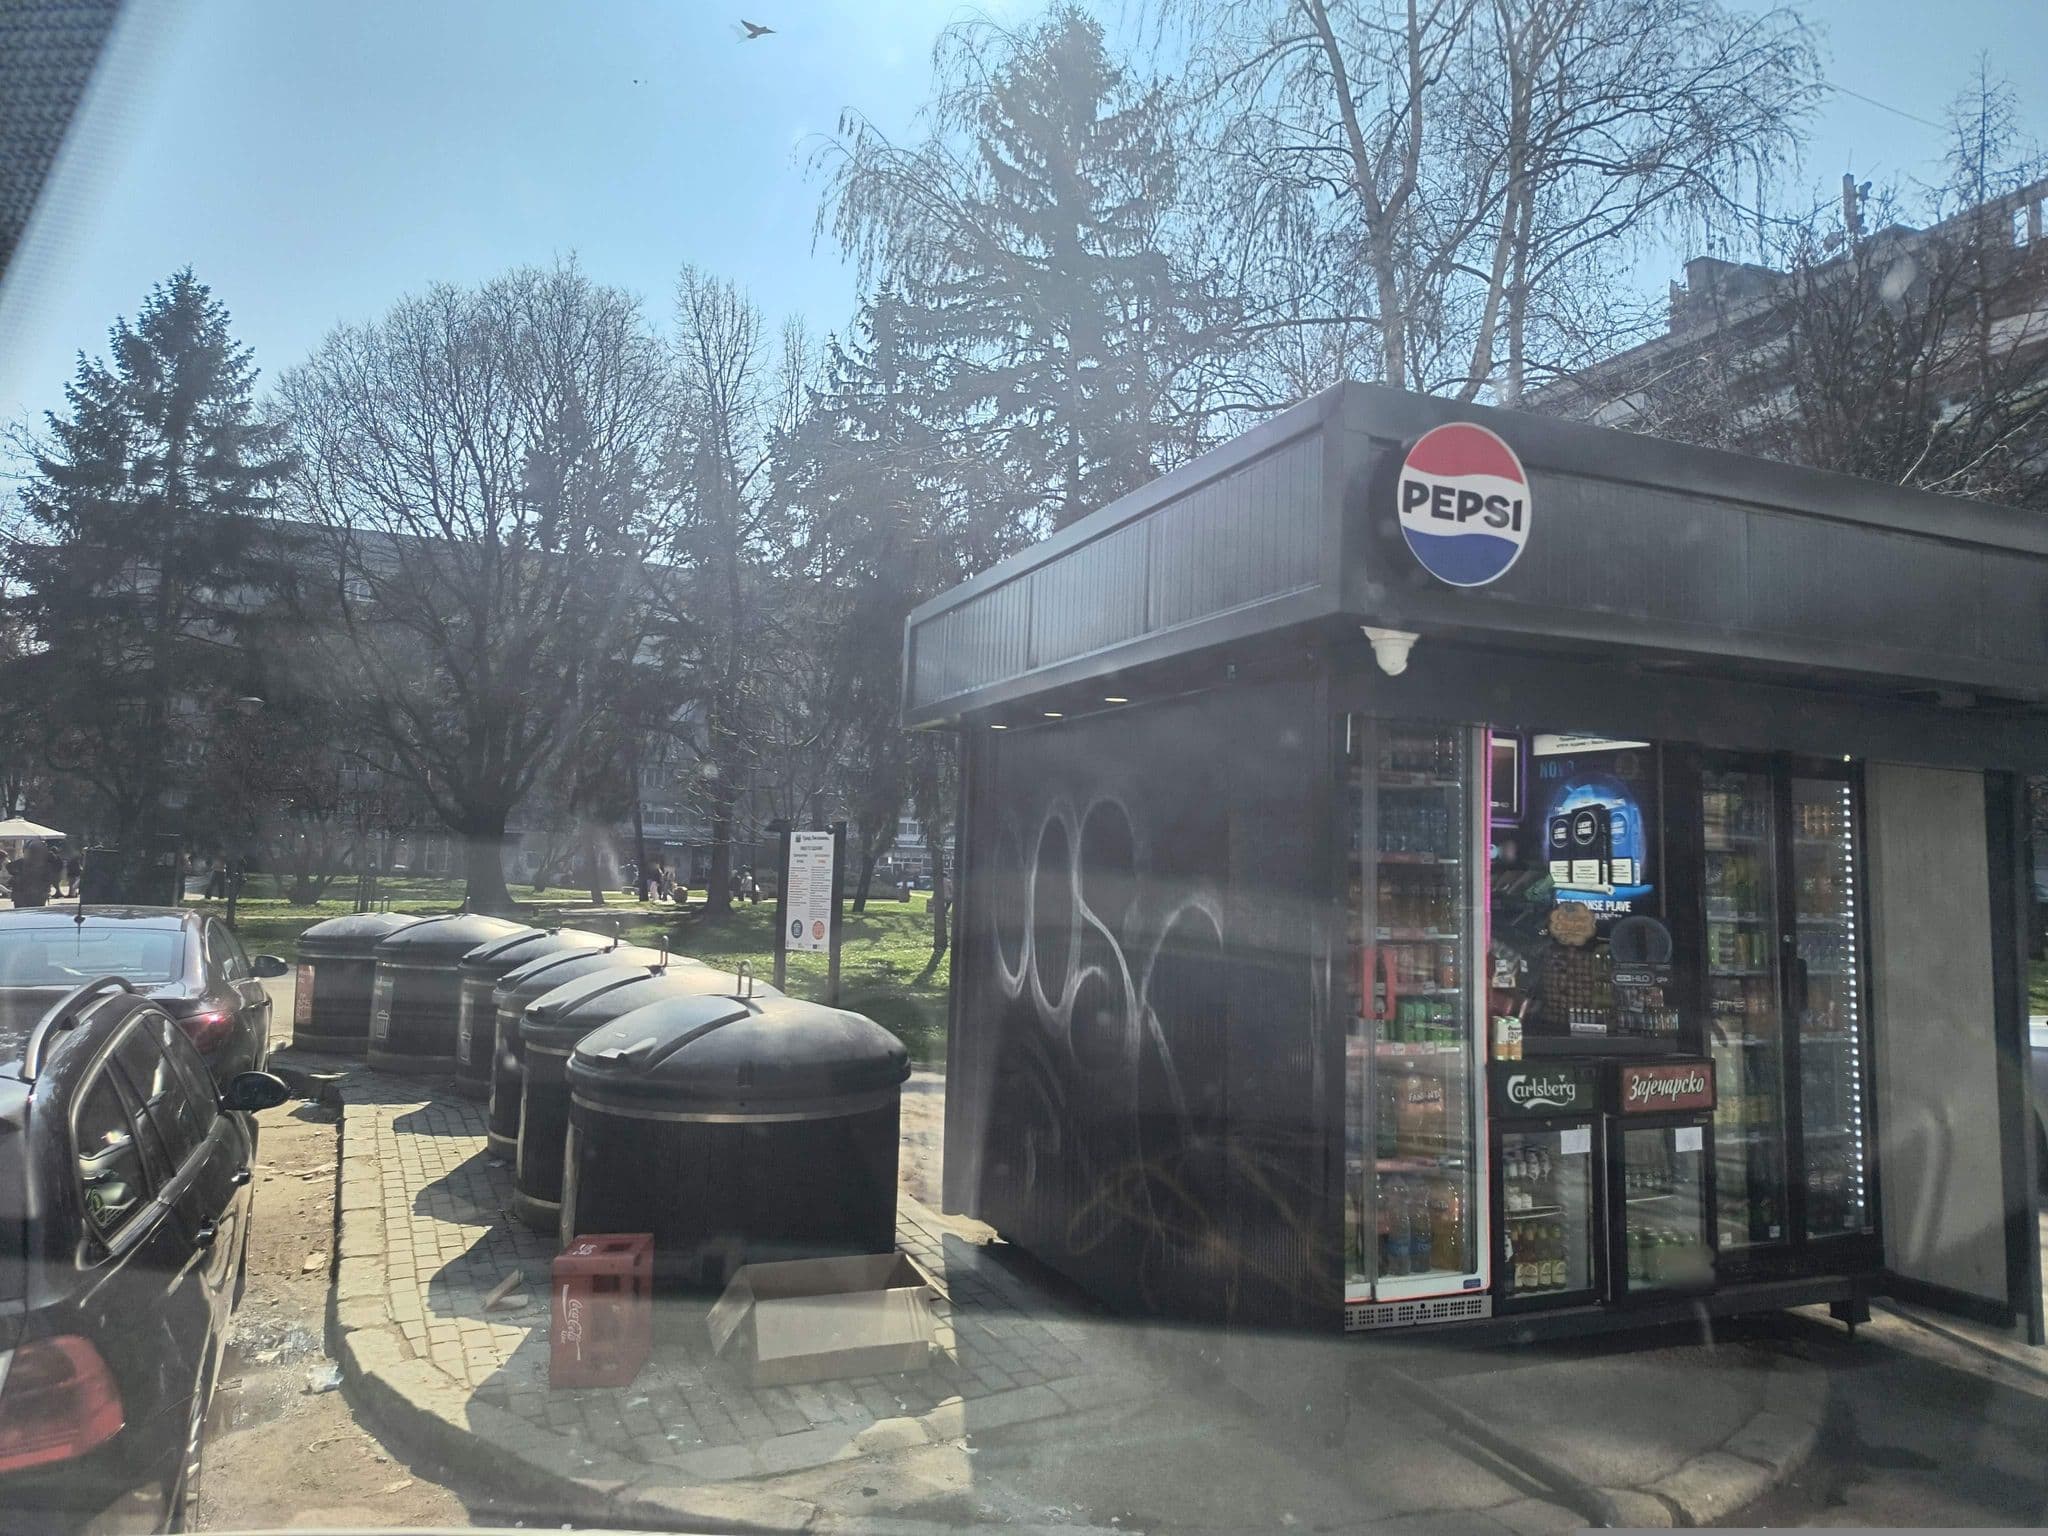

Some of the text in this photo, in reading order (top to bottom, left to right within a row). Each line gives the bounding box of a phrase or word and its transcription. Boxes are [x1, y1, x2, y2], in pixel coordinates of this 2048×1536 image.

[1402, 479, 1523, 532] PEPSI
[1606, 901, 1632, 913] PLAVE
[1507, 1074, 1576, 1108] Carlsberg
[1628, 1070, 1705, 1104] Зајечарско
